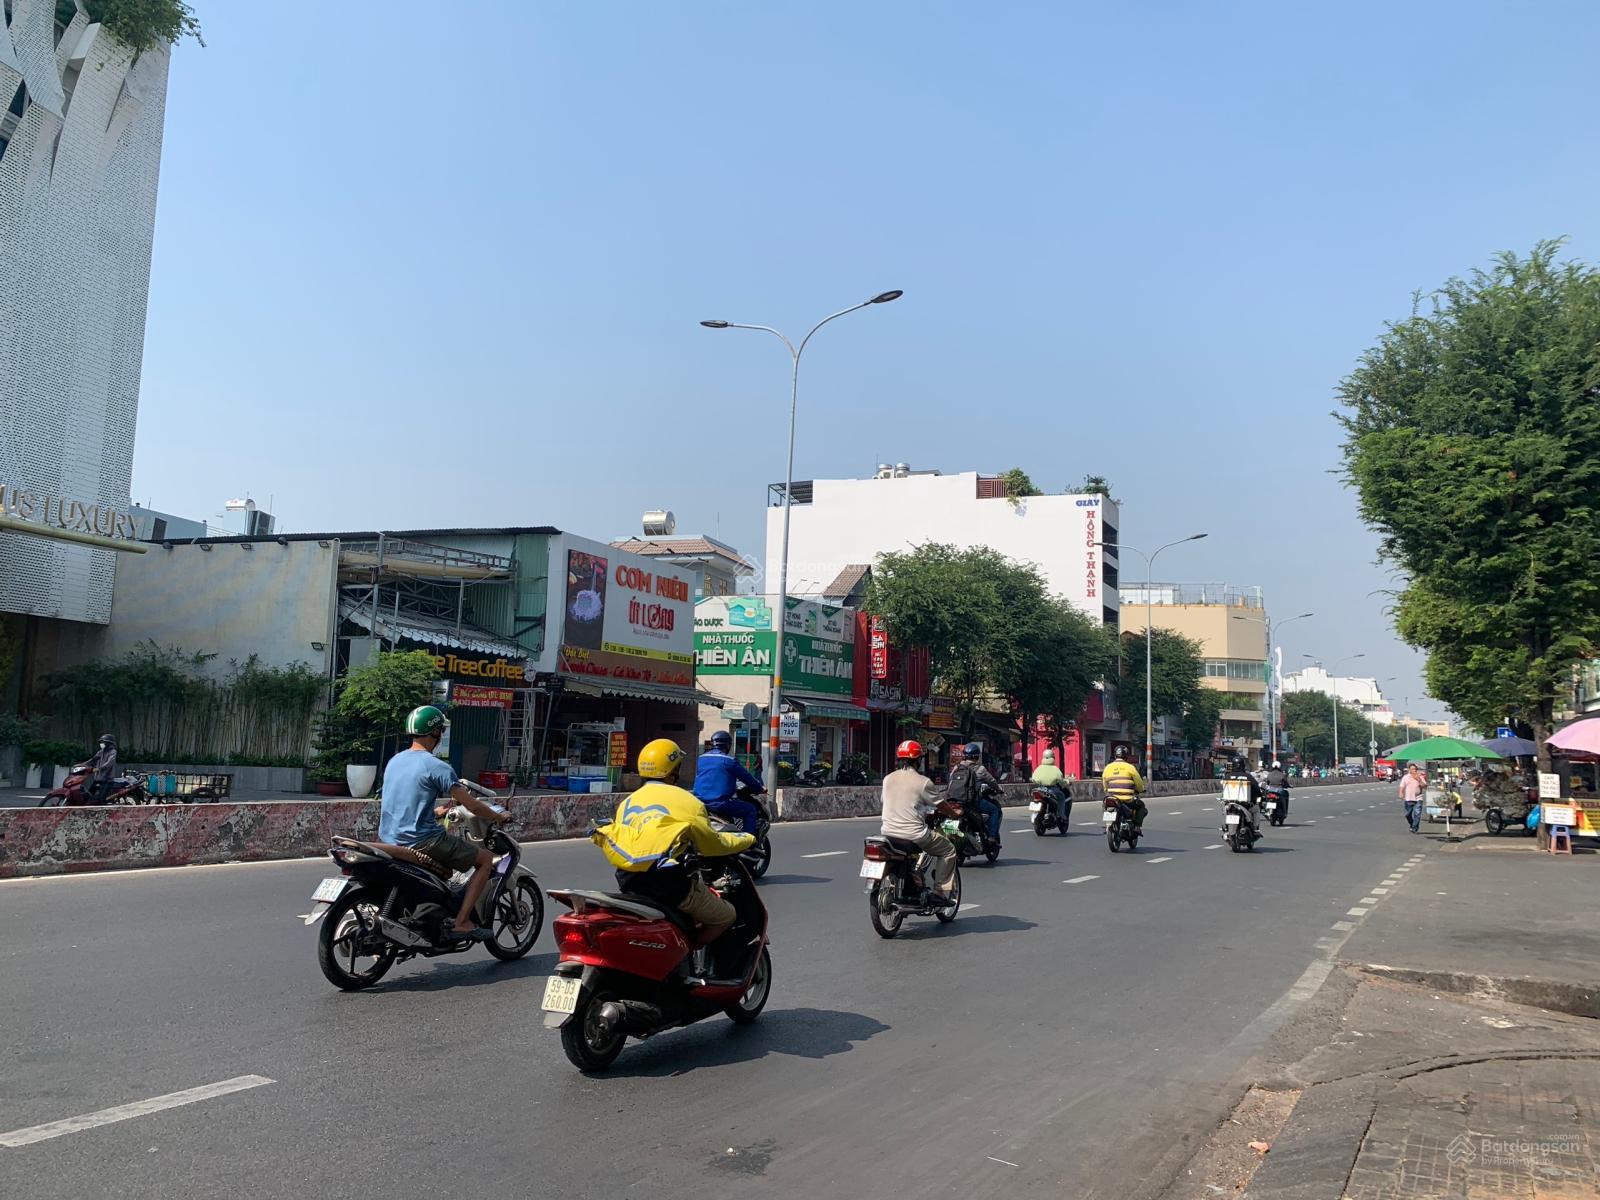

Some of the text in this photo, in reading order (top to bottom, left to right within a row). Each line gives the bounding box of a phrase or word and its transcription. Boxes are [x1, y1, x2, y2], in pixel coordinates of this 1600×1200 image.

[703, 632, 755, 644] NHÀ THUỐC
[741, 646, 771, 667] ÂN
[799, 654, 853, 679] THIÊN ÂN
[629, 940, 667, 949] LEAD
